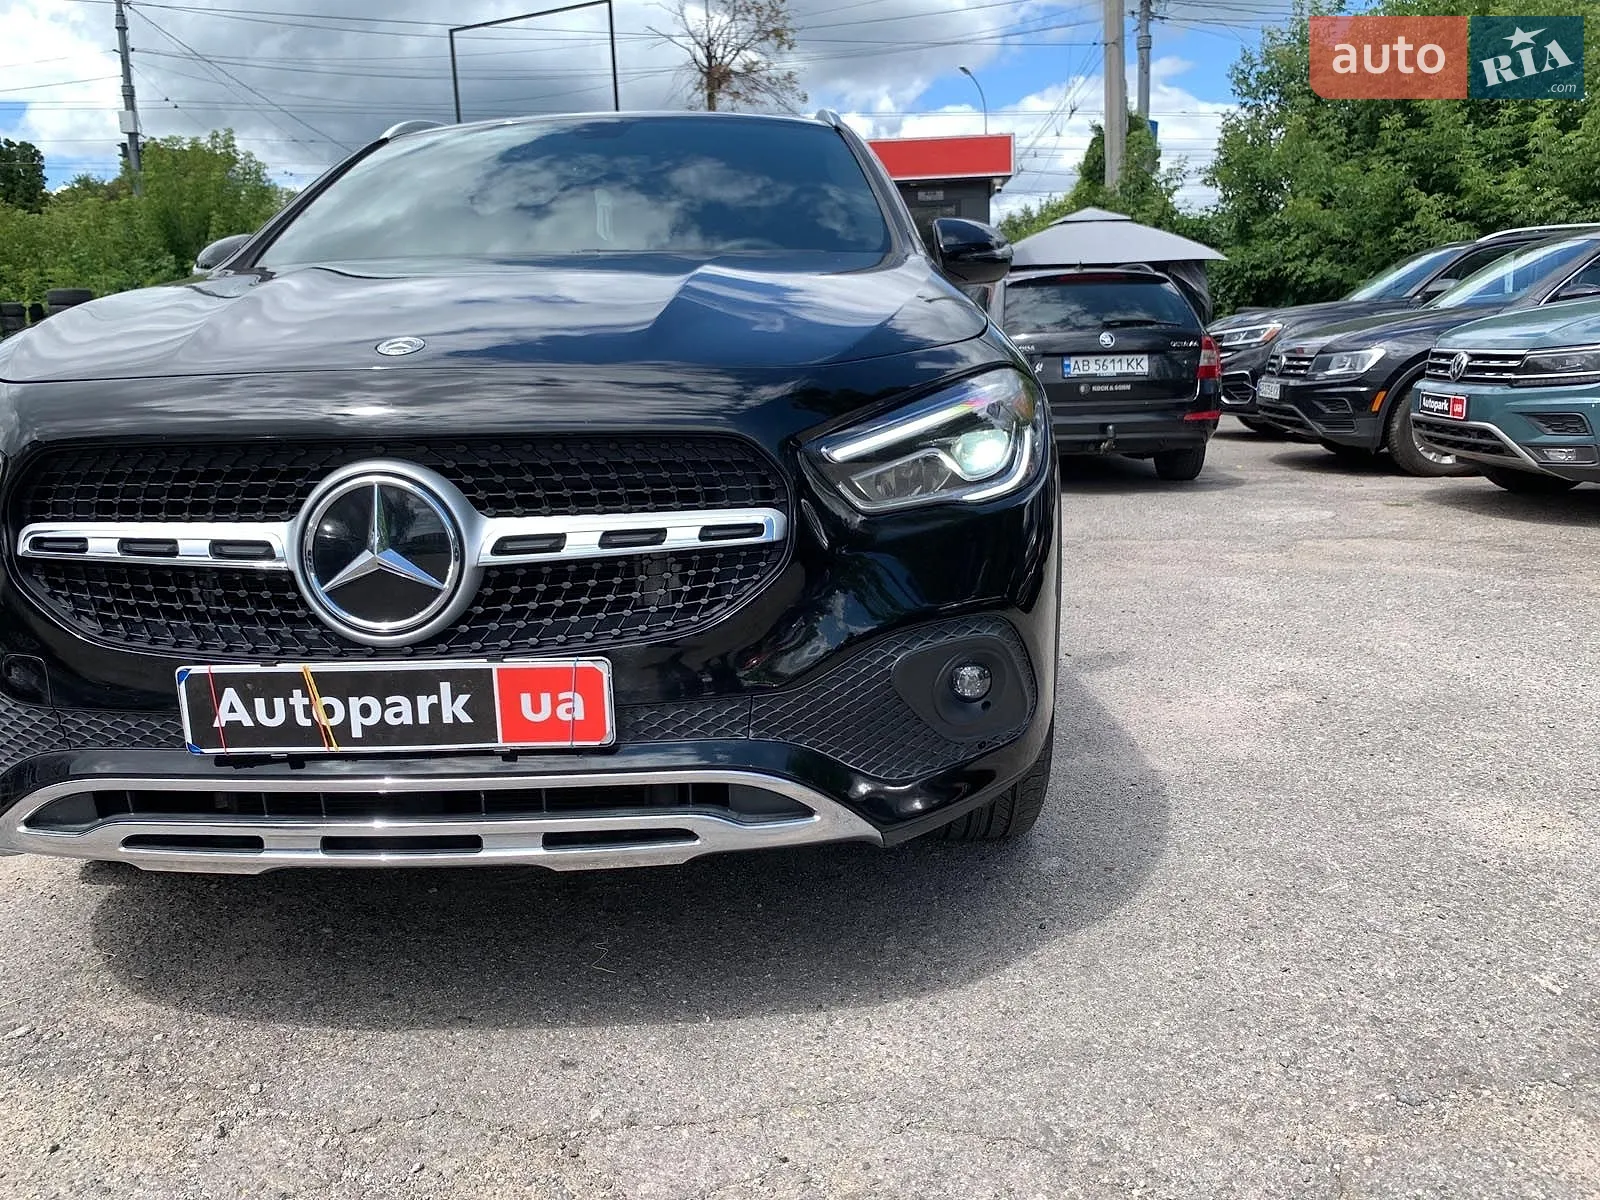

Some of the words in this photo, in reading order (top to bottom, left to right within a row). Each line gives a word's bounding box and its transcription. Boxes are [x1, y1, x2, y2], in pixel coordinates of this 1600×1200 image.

[1072, 359, 1090, 372] AB
[1094, 358, 1123, 372] 5611
[1126, 357, 1144, 371] KK
[1423, 397, 1448, 411] Autopark
[1454, 404, 1462, 412] ua
[213, 681, 474, 738] Autopark
[519, 689, 586, 722] ua
